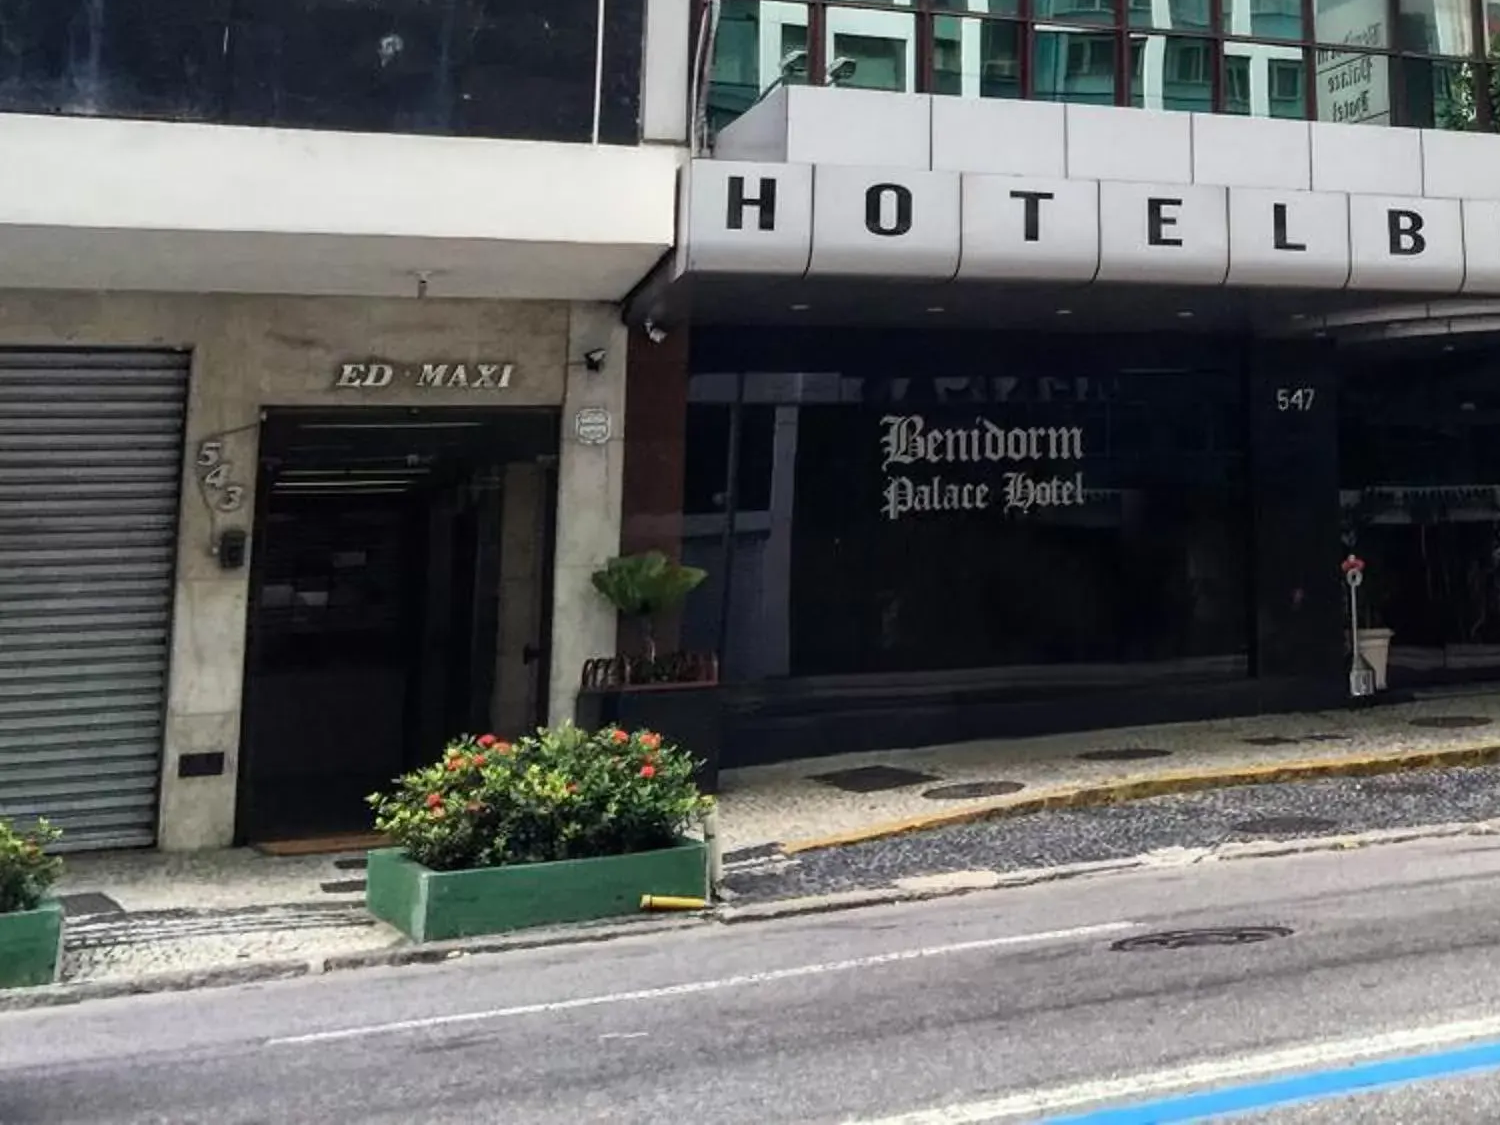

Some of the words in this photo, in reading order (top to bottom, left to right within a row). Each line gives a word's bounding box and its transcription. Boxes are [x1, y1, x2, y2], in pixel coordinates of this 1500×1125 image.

[726, 176, 1307, 252] HOTEL
[335, 363, 394, 388] ED
[415, 363, 514, 388] MAXI
[1277, 388, 1316, 411] 547
[880, 415, 1084, 471] Benidorm
[880, 475, 990, 519] Palace
[1003, 471, 1085, 513] Hotel
